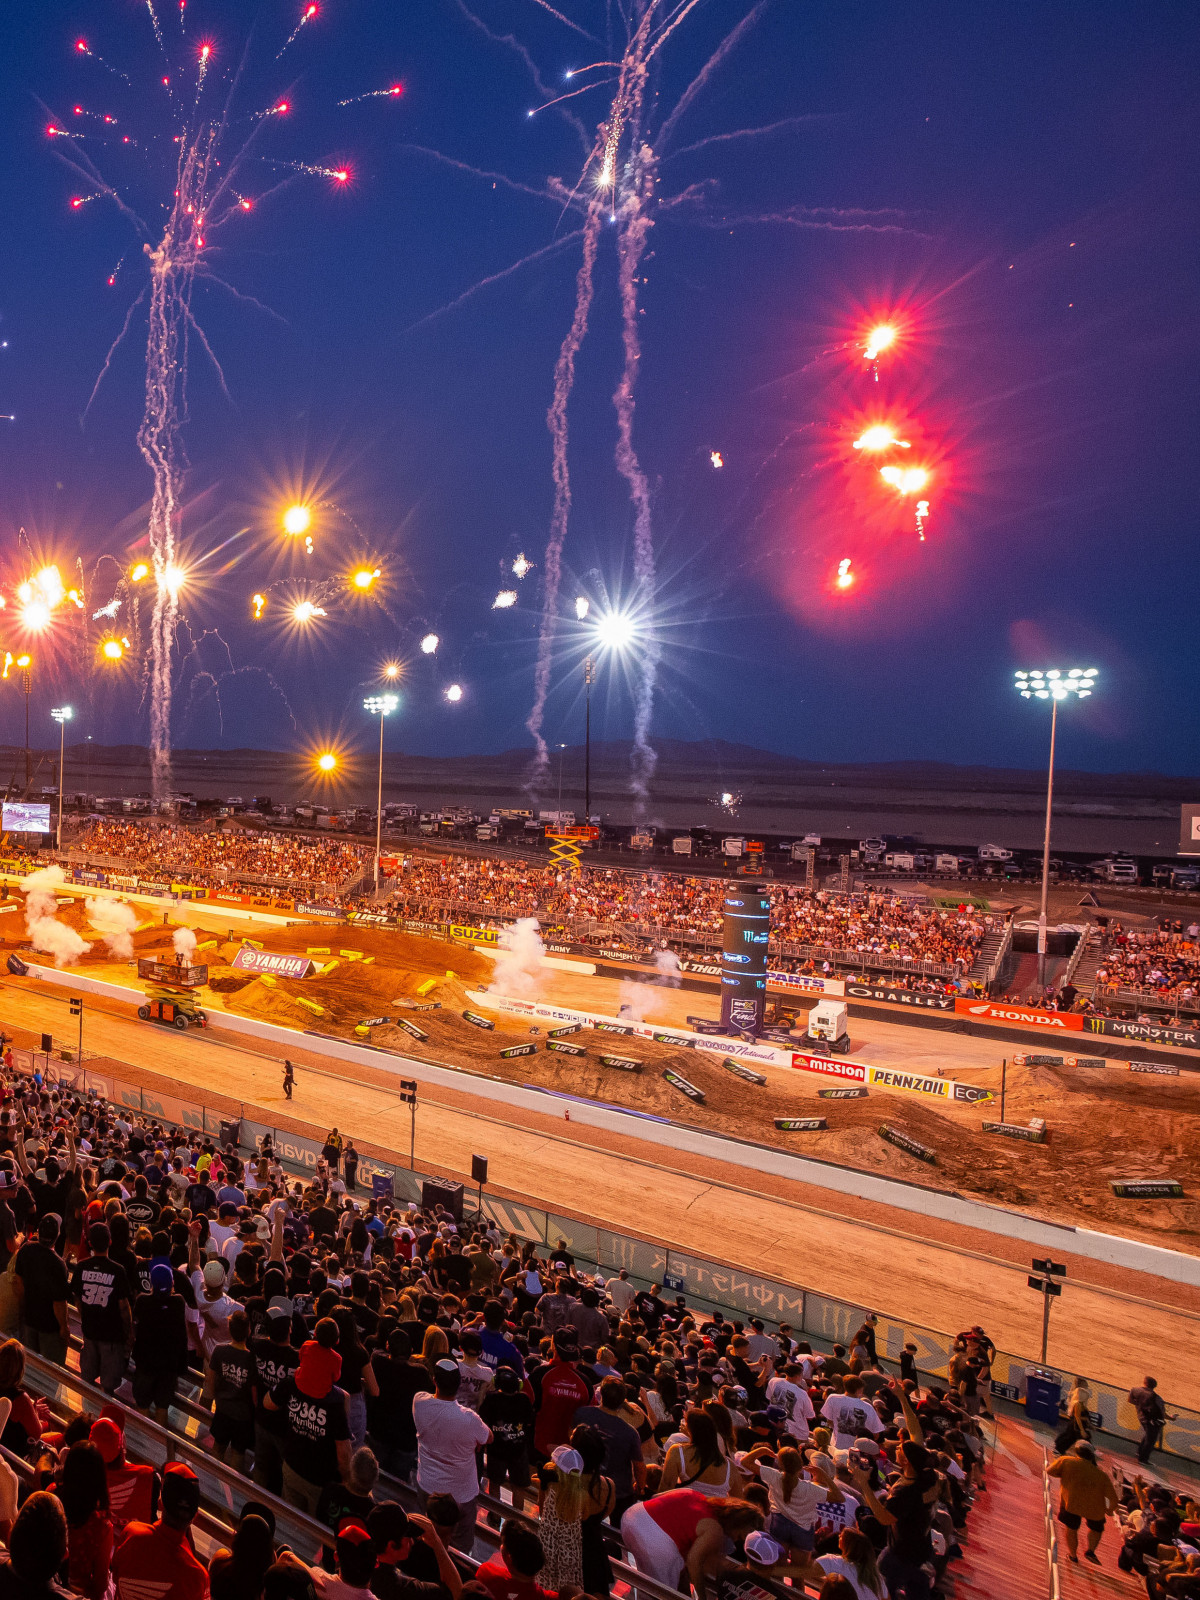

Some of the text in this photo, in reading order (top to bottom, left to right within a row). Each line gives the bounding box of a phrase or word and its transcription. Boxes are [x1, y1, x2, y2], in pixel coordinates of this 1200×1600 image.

[217, 893, 242, 902] GASGAS
[274, 902, 292, 910] KTM
[304, 905, 337, 917] Husqvarna
[549, 945, 571, 954] ARMY
[598, 949, 634, 961] TRIUMPH
[255, 953, 303, 973] YAMAHA
[243, 964, 296, 976] RACING
[766, 979, 825, 993] NLIMITED
[874, 991, 950, 1009] OAKLEY
[729, 1010, 757, 1022] Final
[989, 1008, 1067, 1028] HONDA
[556, 1026, 576, 1037] UFO
[601, 1024, 628, 1035] UFO
[1112, 1022, 1198, 1044] MONSTER
[661, 1036, 689, 1046] UFO
[509, 1046, 531, 1058] UFO
[553, 1044, 579, 1056] UFO
[696, 1036, 775, 1061] EVADA Nationals
[607, 1059, 636, 1070] UFO
[670, 1076, 698, 1097] UFO
[873, 1070, 946, 1096] PENNZOIL
[830, 1089, 860, 1099] UFO
[788, 1120, 821, 1129] UFO
[81, 1270, 114, 1286] DEEGAN
[81, 1283, 113, 1308] 38
[230, 1363, 248, 1378] 365
[556, 1388, 582, 1400] YAMAHA
[299, 1402, 327, 1426] 365
[288, 1411, 326, 1437] Plumbing
